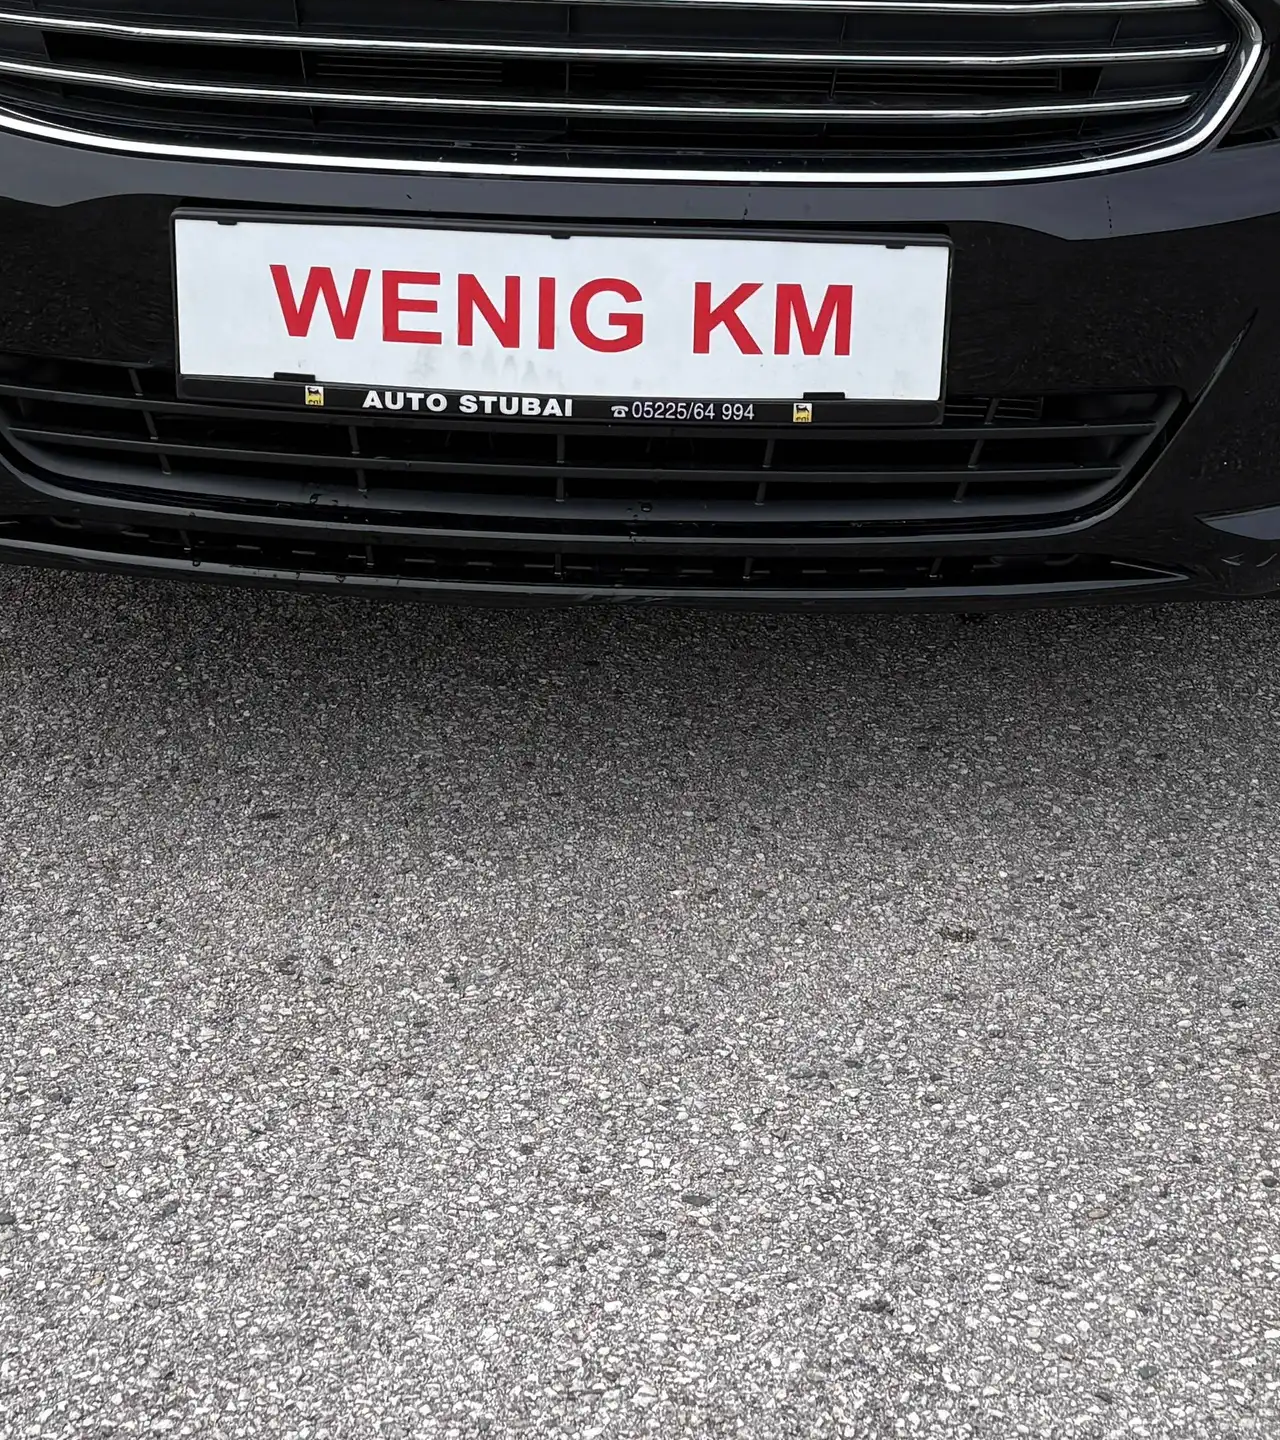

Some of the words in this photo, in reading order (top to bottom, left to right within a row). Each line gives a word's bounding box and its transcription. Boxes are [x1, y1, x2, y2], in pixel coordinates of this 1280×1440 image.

[270, 264, 644, 353] WENIG
[693, 281, 853, 356] KM
[362, 389, 448, 412] AUTO
[458, 394, 573, 418] STUBAI
[631, 400, 716, 421] 05225/64
[721, 402, 755, 421] 994
